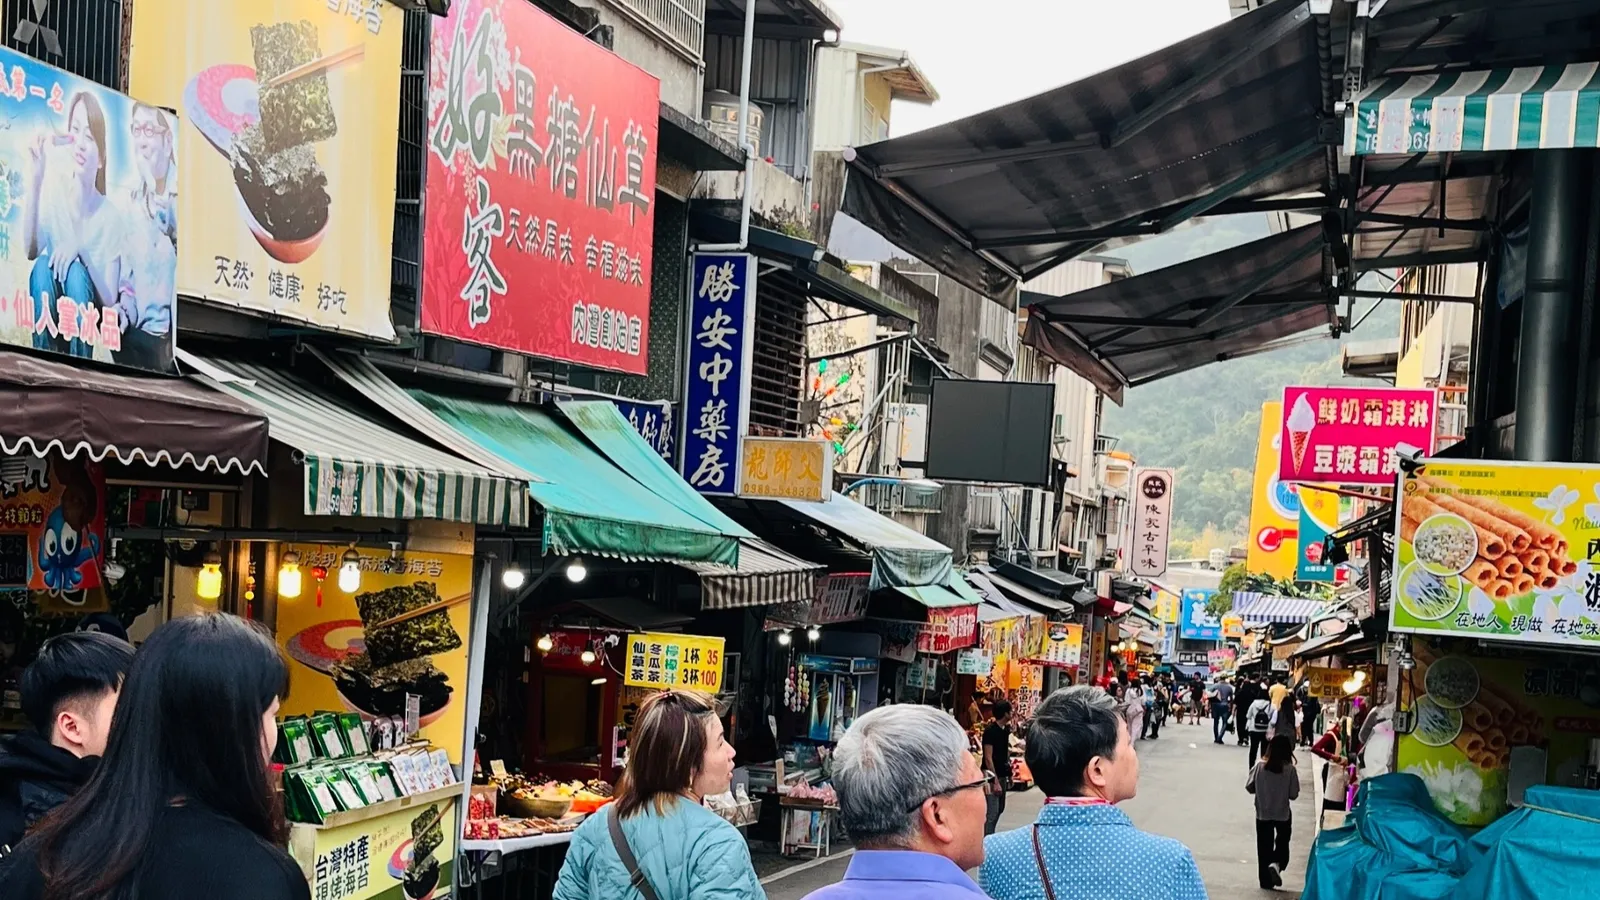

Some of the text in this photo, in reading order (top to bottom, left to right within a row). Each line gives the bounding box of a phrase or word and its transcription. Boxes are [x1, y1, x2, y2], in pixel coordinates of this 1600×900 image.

[505, 64, 650, 226] 黑糖仙草
[505, 208, 644, 287] 天然原味 幸福滋味
[317, 282, 347, 315] 好吃
[690, 260, 741, 487] 勝安中藥房
[1317, 397, 1429, 428] 鮮奶霜淇淋
[745, 448, 820, 481] 龍師父
[1313, 444, 1401, 476] 豆漿霜淇
[1511, 615, 1543, 633] 現做
[631, 641, 646, 681] 仙草茶
[648, 643, 662, 682] 冬瓜茶
[683, 648, 718, 665] 1杯 35
[682, 668, 717, 686] 3杯 100
[315, 835, 369, 883] 台灣特產
[315, 863, 369, 900] 現烤海苔
